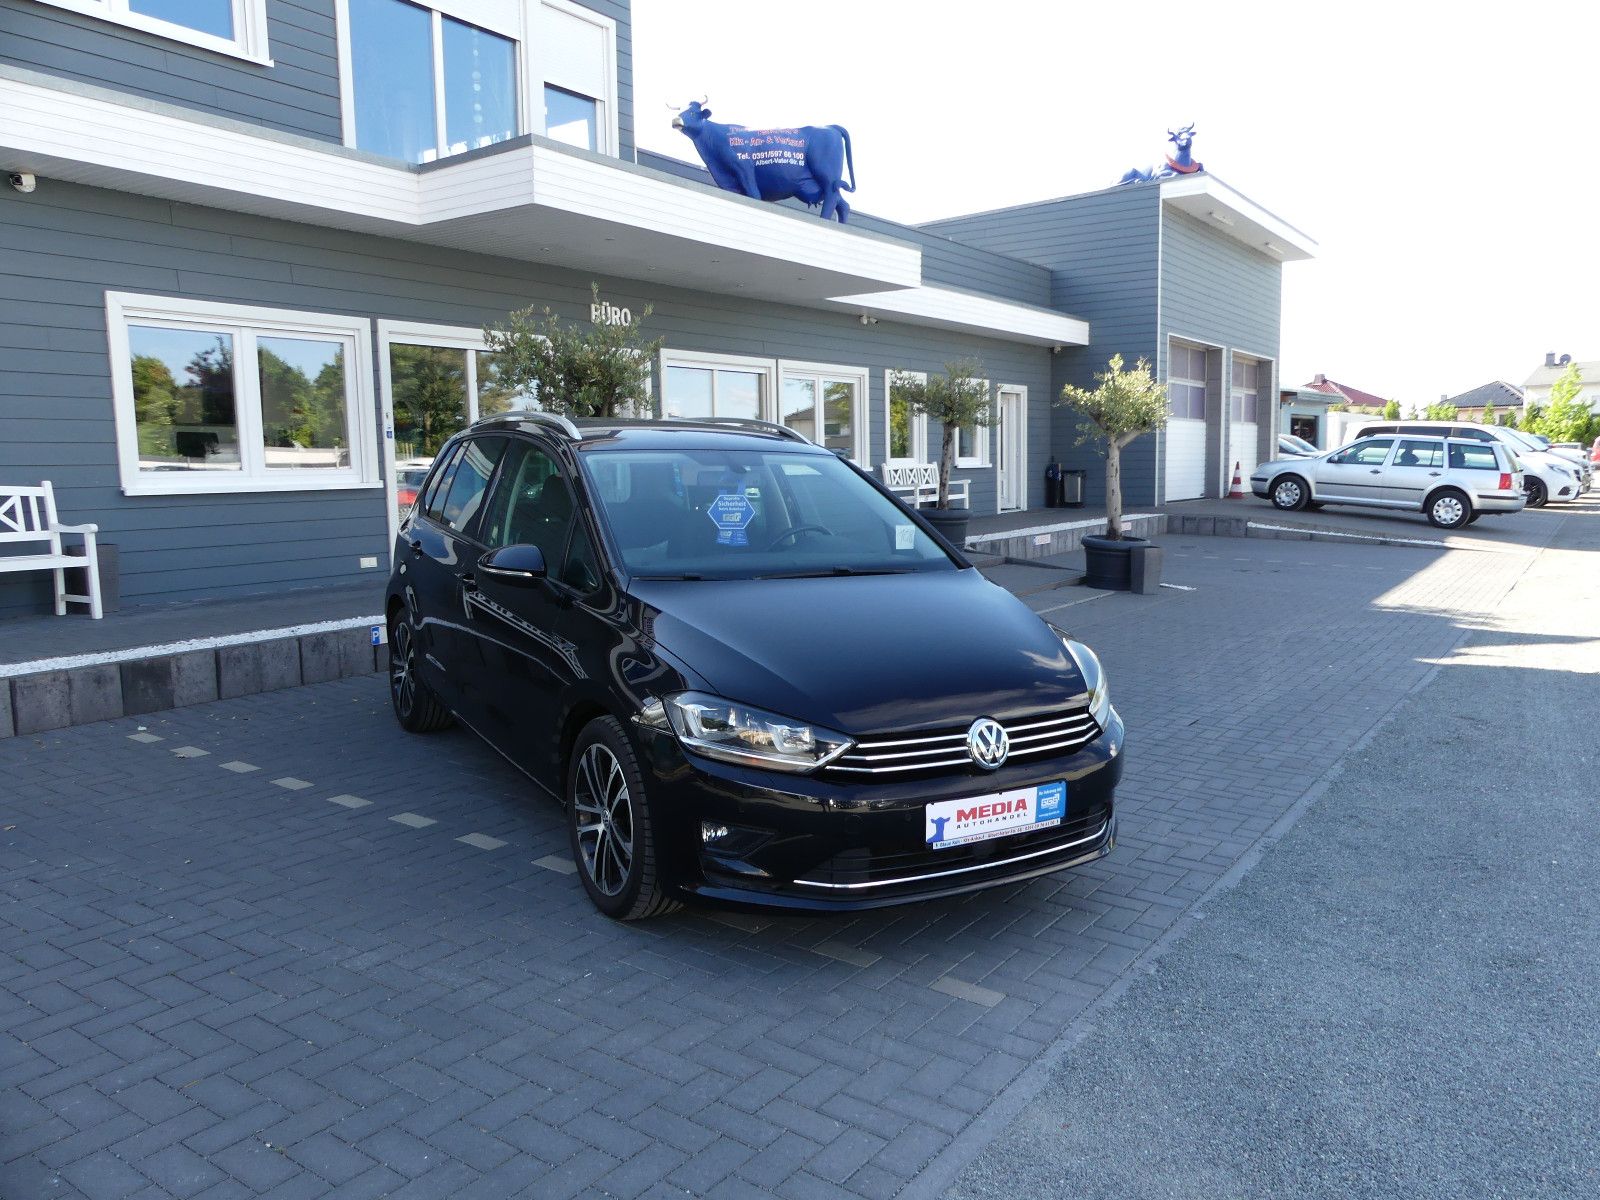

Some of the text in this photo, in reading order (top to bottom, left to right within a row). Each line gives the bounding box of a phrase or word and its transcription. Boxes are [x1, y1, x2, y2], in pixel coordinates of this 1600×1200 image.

[736, 152, 750, 160] Tel.
[591, 301, 632, 327] BÜRO
[372, 631, 379, 642] P
[956, 798, 1028, 822] MEDIA
[956, 812, 1028, 830] AUTOHANDEL
